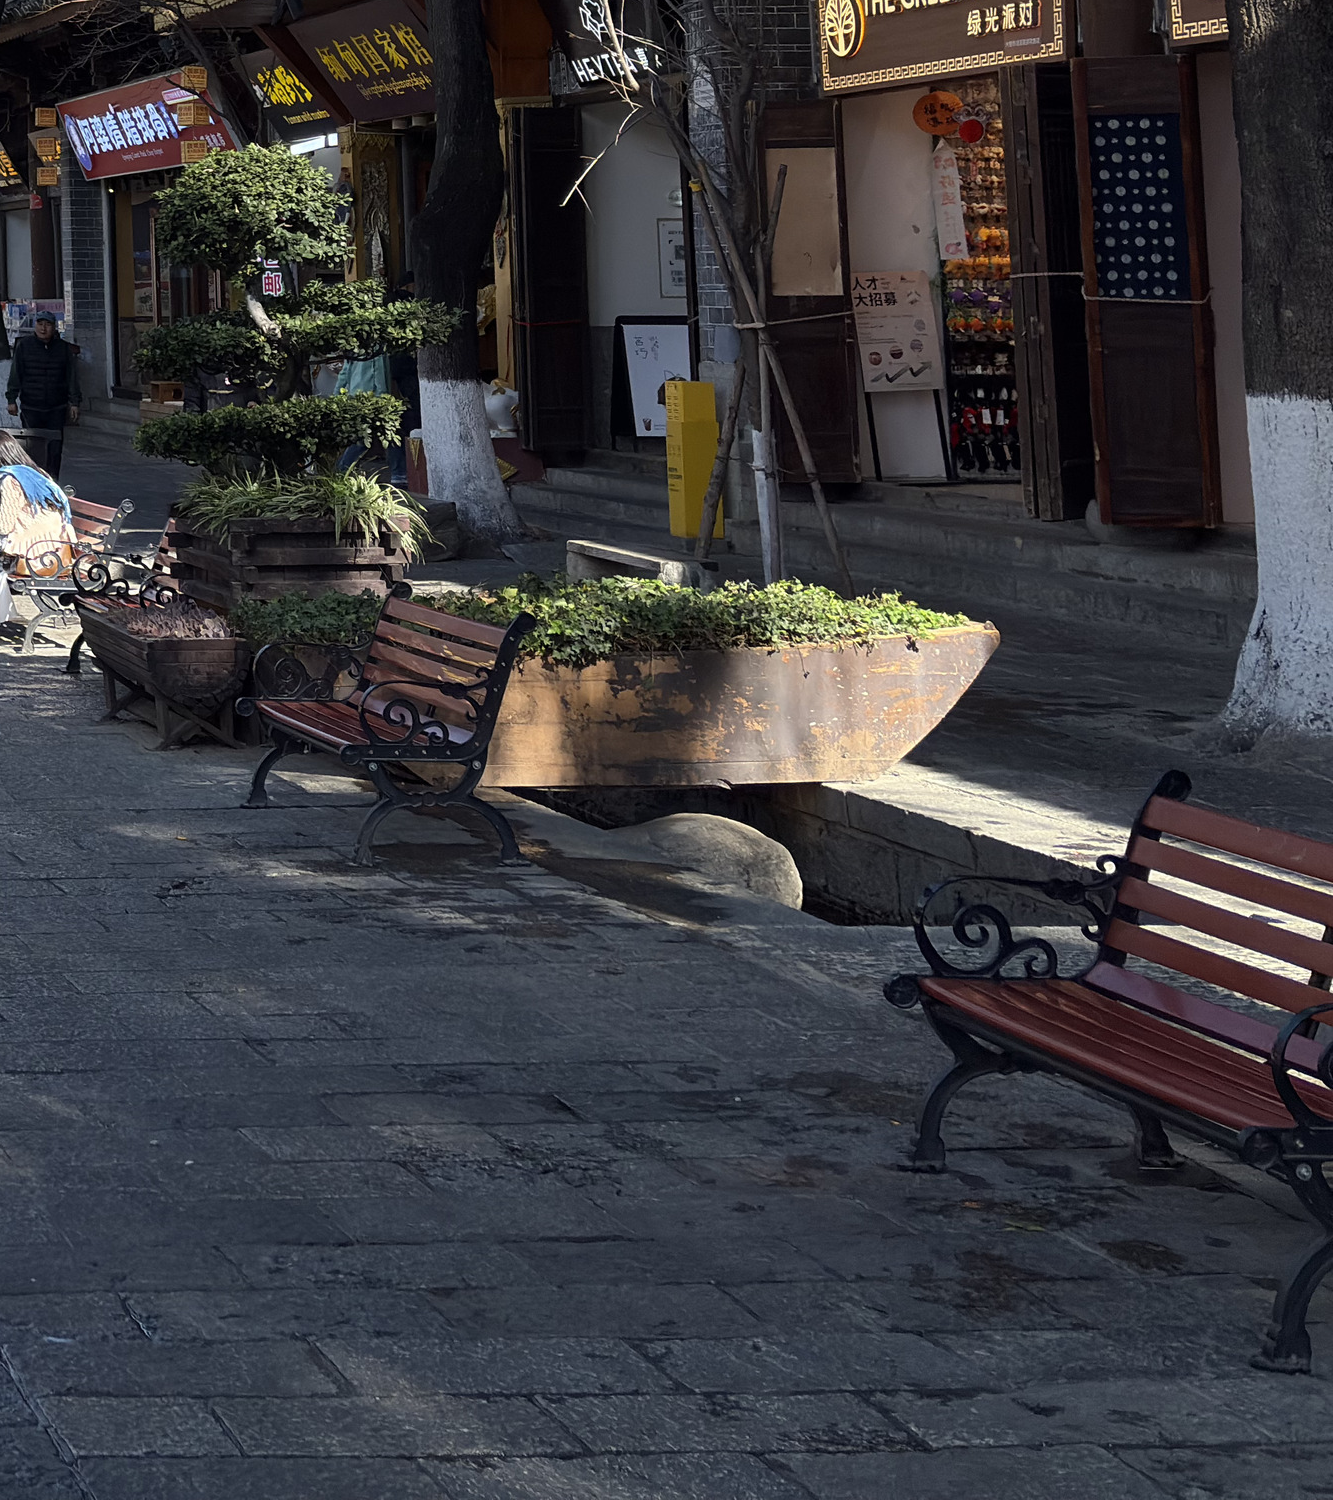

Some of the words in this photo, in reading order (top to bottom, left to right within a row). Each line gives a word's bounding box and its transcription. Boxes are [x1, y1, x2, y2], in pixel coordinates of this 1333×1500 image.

[967, 0, 1034, 36] 绿光派对
[315, 22, 434, 83] 缅甸国家馆
[852, 275, 879, 291] 人才
[854, 291, 898, 308] 大招募
